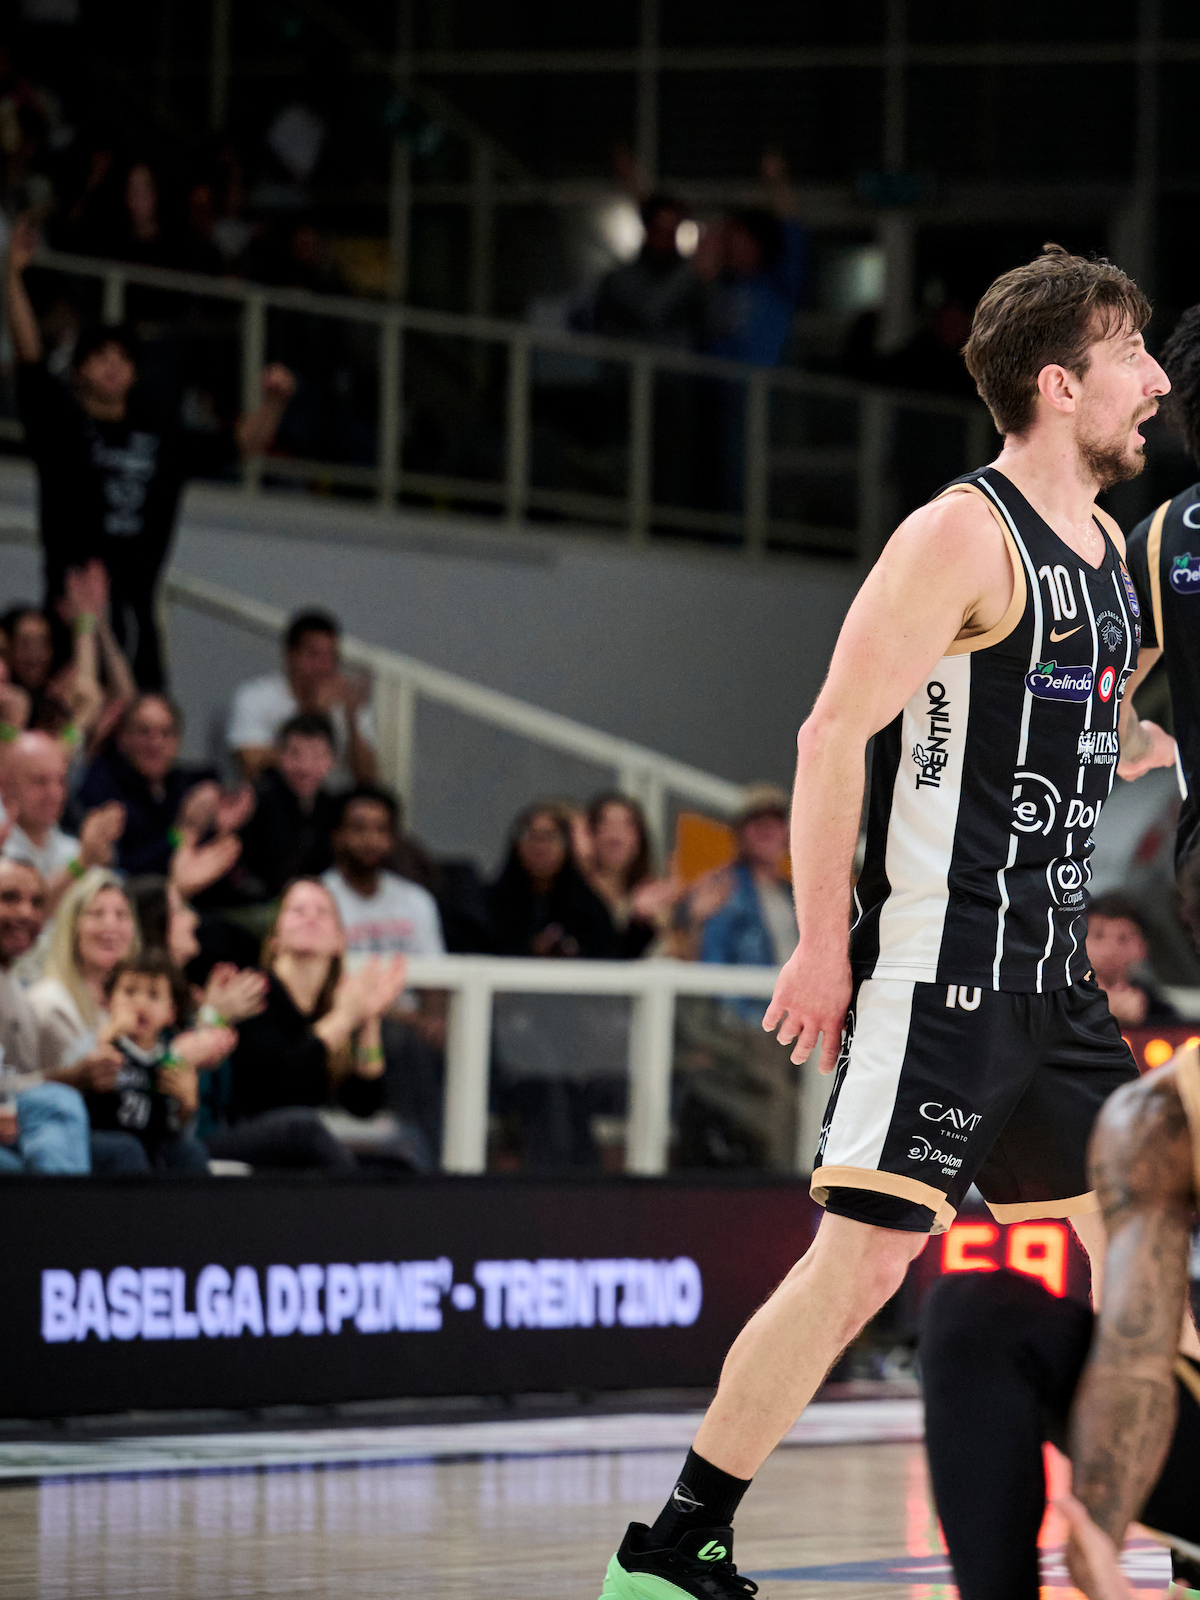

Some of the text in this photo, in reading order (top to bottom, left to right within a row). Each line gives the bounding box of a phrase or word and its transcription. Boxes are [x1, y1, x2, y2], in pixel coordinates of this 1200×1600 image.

[1038, 564, 1078, 621] 10
[1029, 673, 1093, 691] Melinda
[915, 681, 952, 790] TRENTINO
[1095, 730, 1119, 754] ITAS
[941, 1129, 968, 1143] TRENTO
[41, 1263, 265, 1343] BASELGA
[265, 1262, 325, 1337] DI
[473, 1255, 704, 1330] TRENTINO
